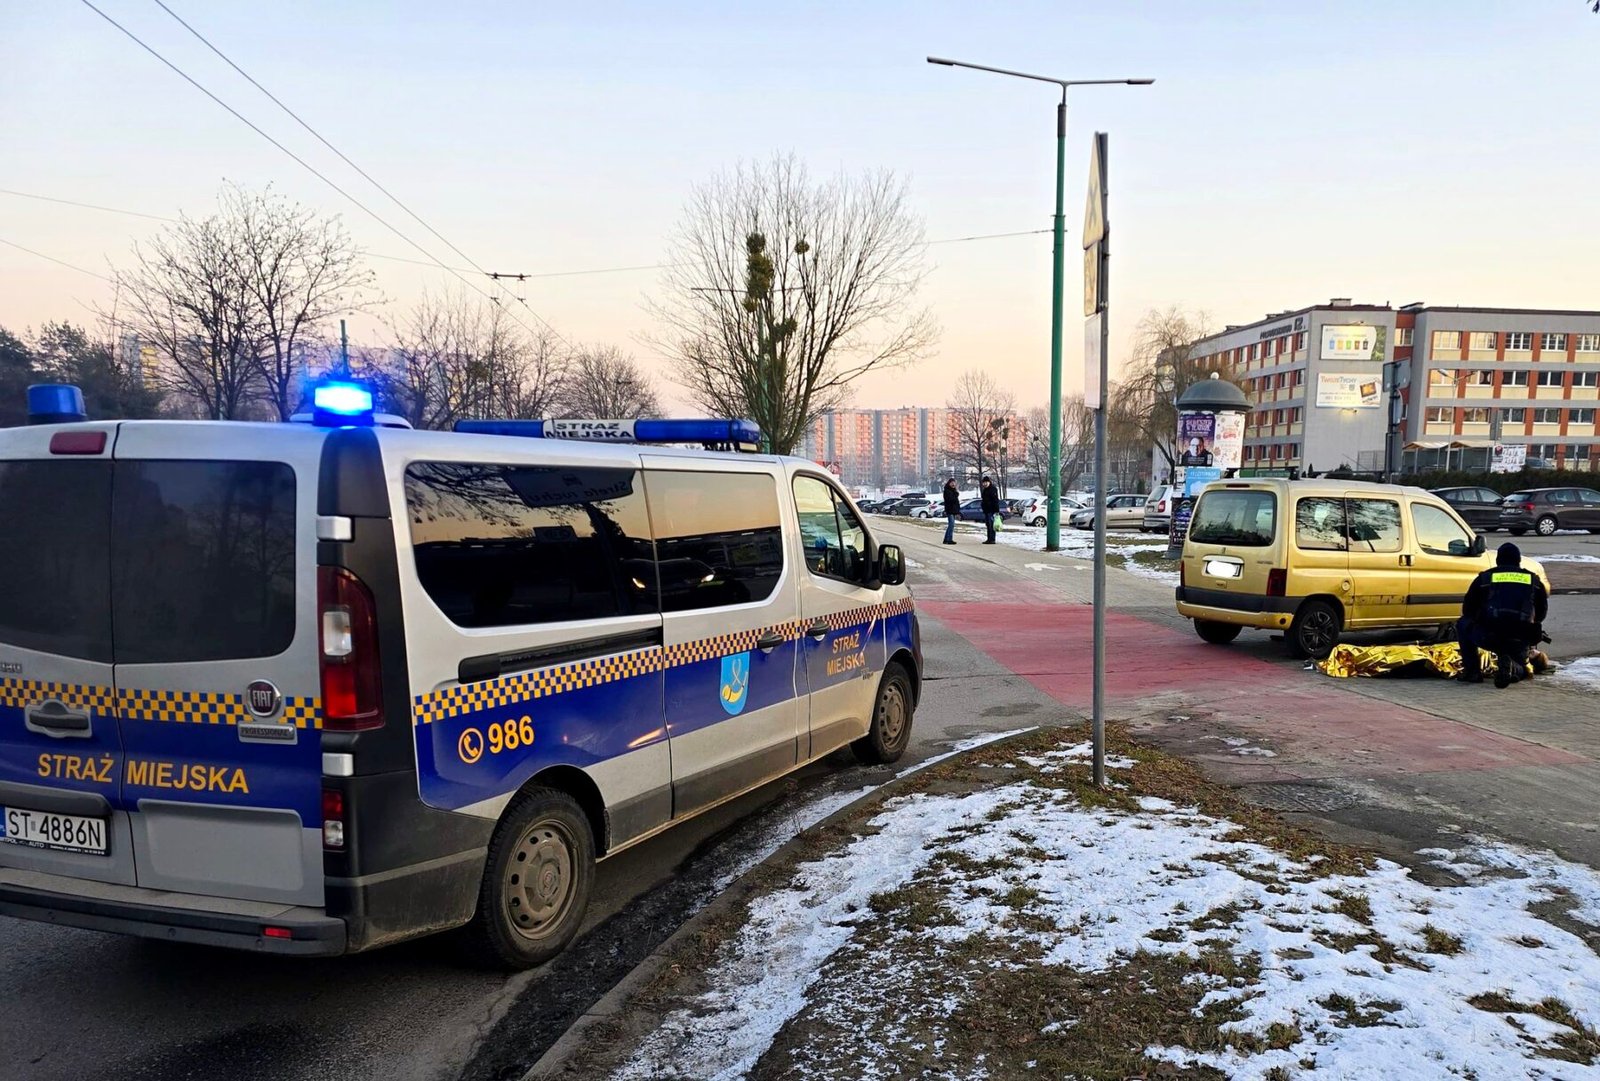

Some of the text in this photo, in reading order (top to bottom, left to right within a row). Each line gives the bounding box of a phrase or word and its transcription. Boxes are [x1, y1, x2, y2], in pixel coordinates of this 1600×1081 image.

[545, 430, 632, 438] MIEJSKA
[832, 630, 860, 654] STRAŻ
[826, 651, 866, 677] MIEJSKA
[252, 690, 272, 708] FIAT
[488, 715, 535, 754] 986
[37, 752, 249, 794] STRAŻ MIEJSKA
[8, 810, 101, 847] ST 4886N
